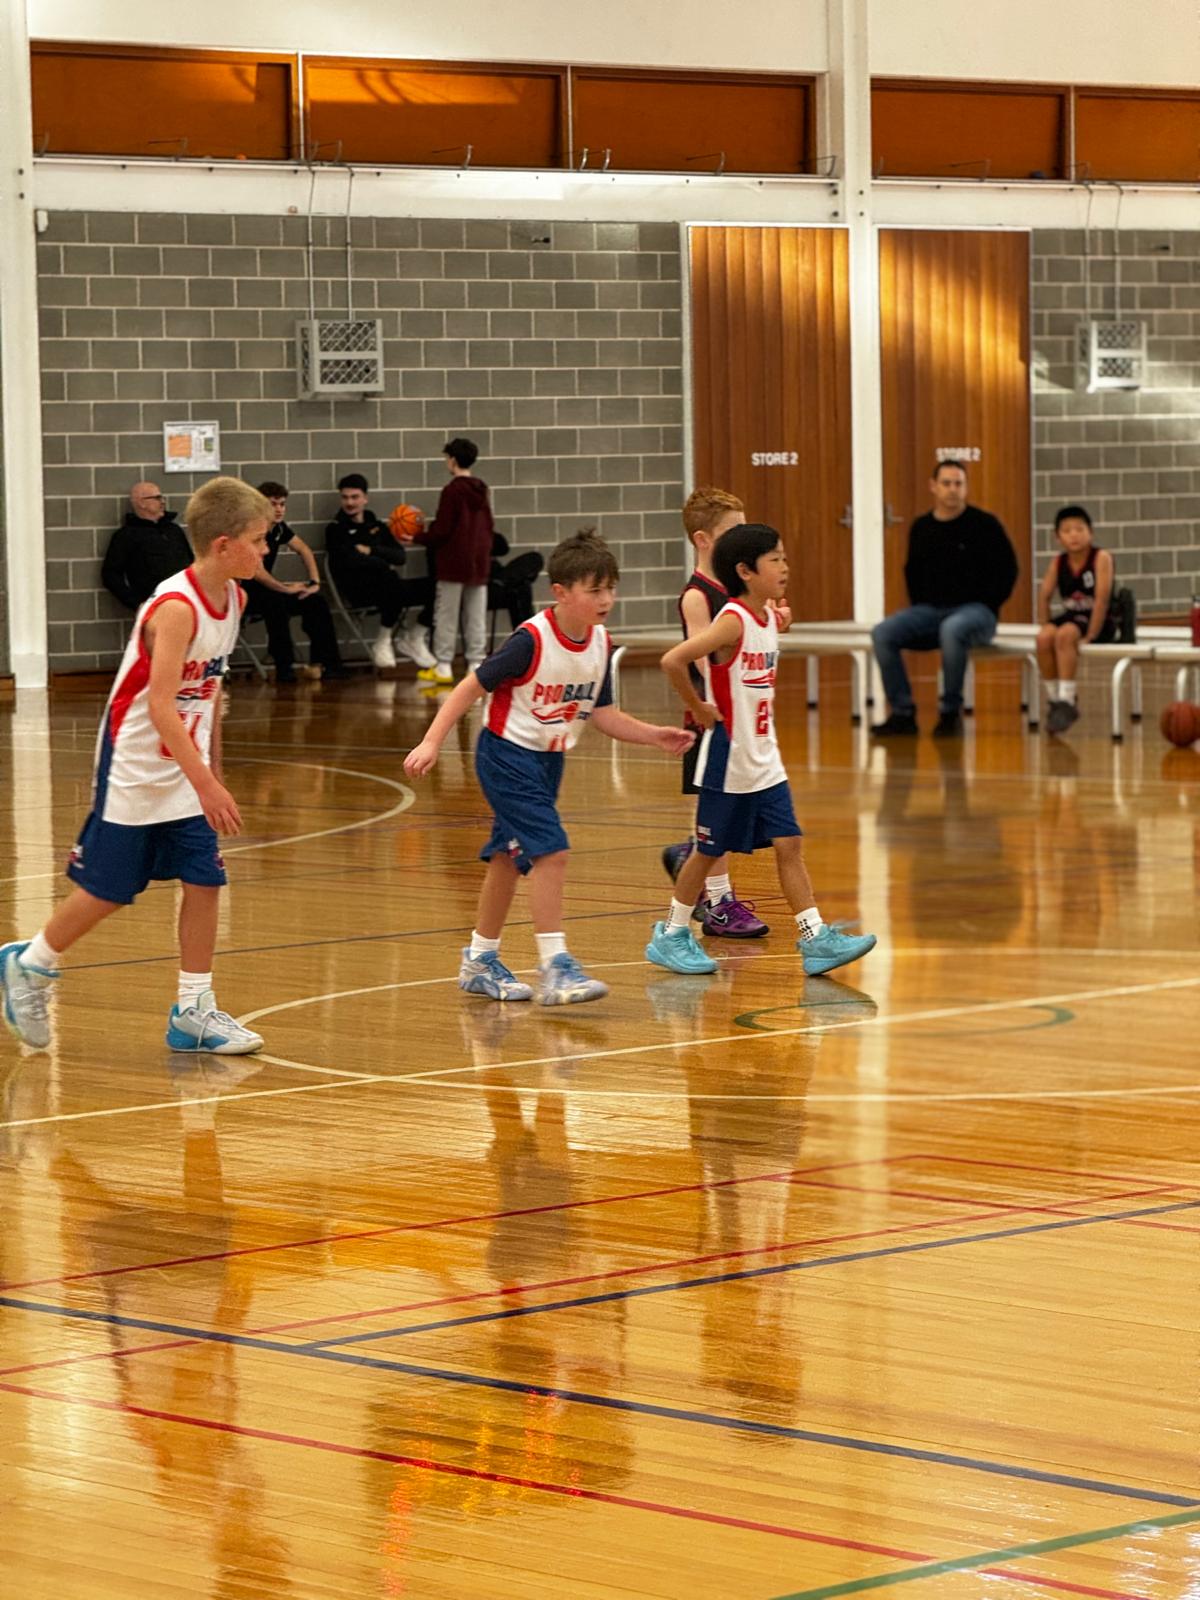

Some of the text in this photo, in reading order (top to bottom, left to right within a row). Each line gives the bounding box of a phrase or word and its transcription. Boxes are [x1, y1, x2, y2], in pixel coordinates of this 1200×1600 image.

[751, 451, 799, 466] STORE 2
[532, 680, 596, 706] PROBALL
